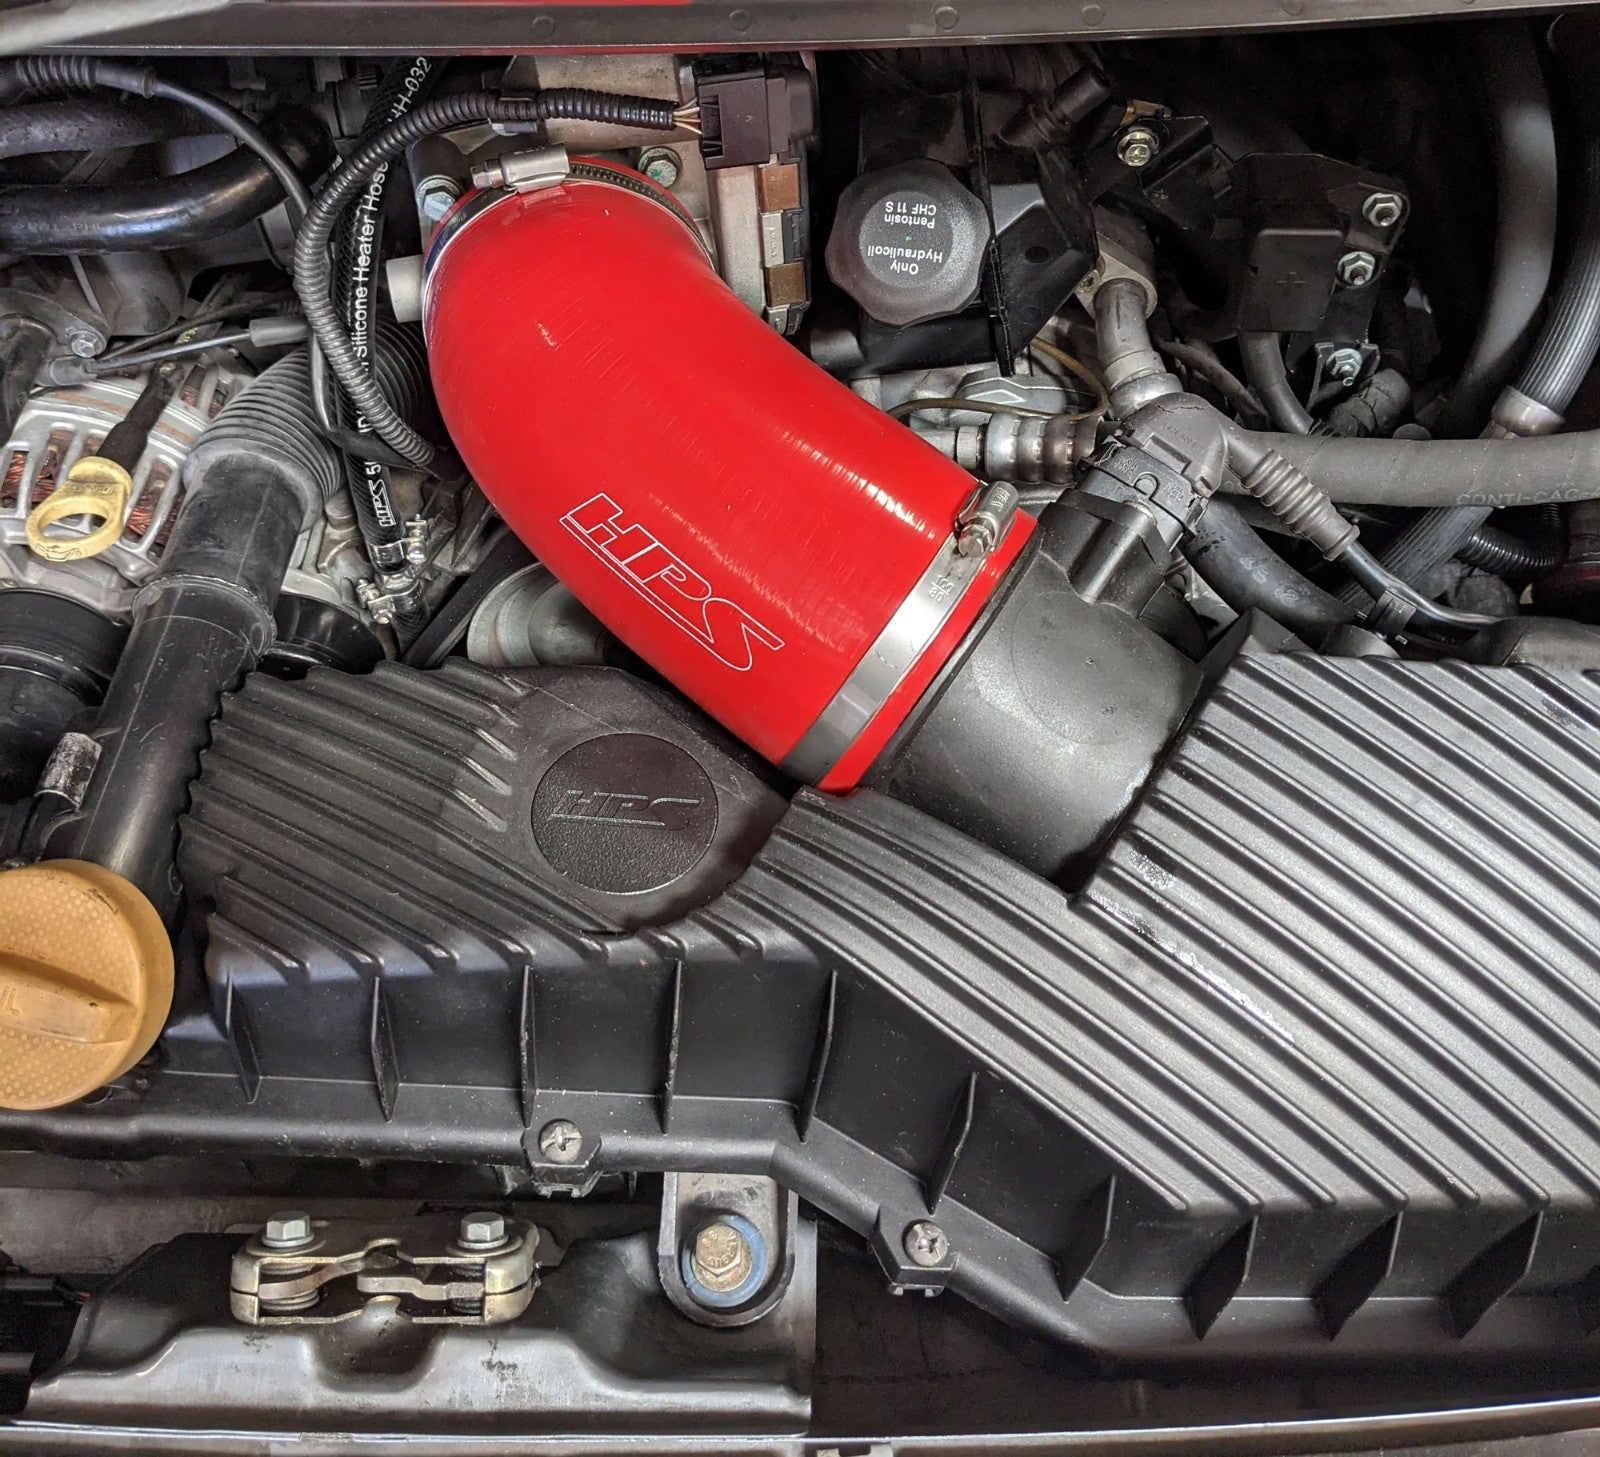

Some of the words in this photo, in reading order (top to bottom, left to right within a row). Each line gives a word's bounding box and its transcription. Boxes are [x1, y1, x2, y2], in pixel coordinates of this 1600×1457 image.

[361, 161, 389, 212] Hose
[884, 213, 936, 229] Pentosin
[885, 201, 894, 213] S
[896, 202, 908, 214] 11
[911, 203, 937, 216] CHF
[351, 214, 376, 281] Heater
[867, 245, 943, 263] Hydraulicoil
[890, 259, 919, 275] Only
[350, 286, 368, 358] Silicone
[367, 479, 397, 527] HPS
[559, 493, 785, 671] HPS
[547, 789, 700, 831] HPS
